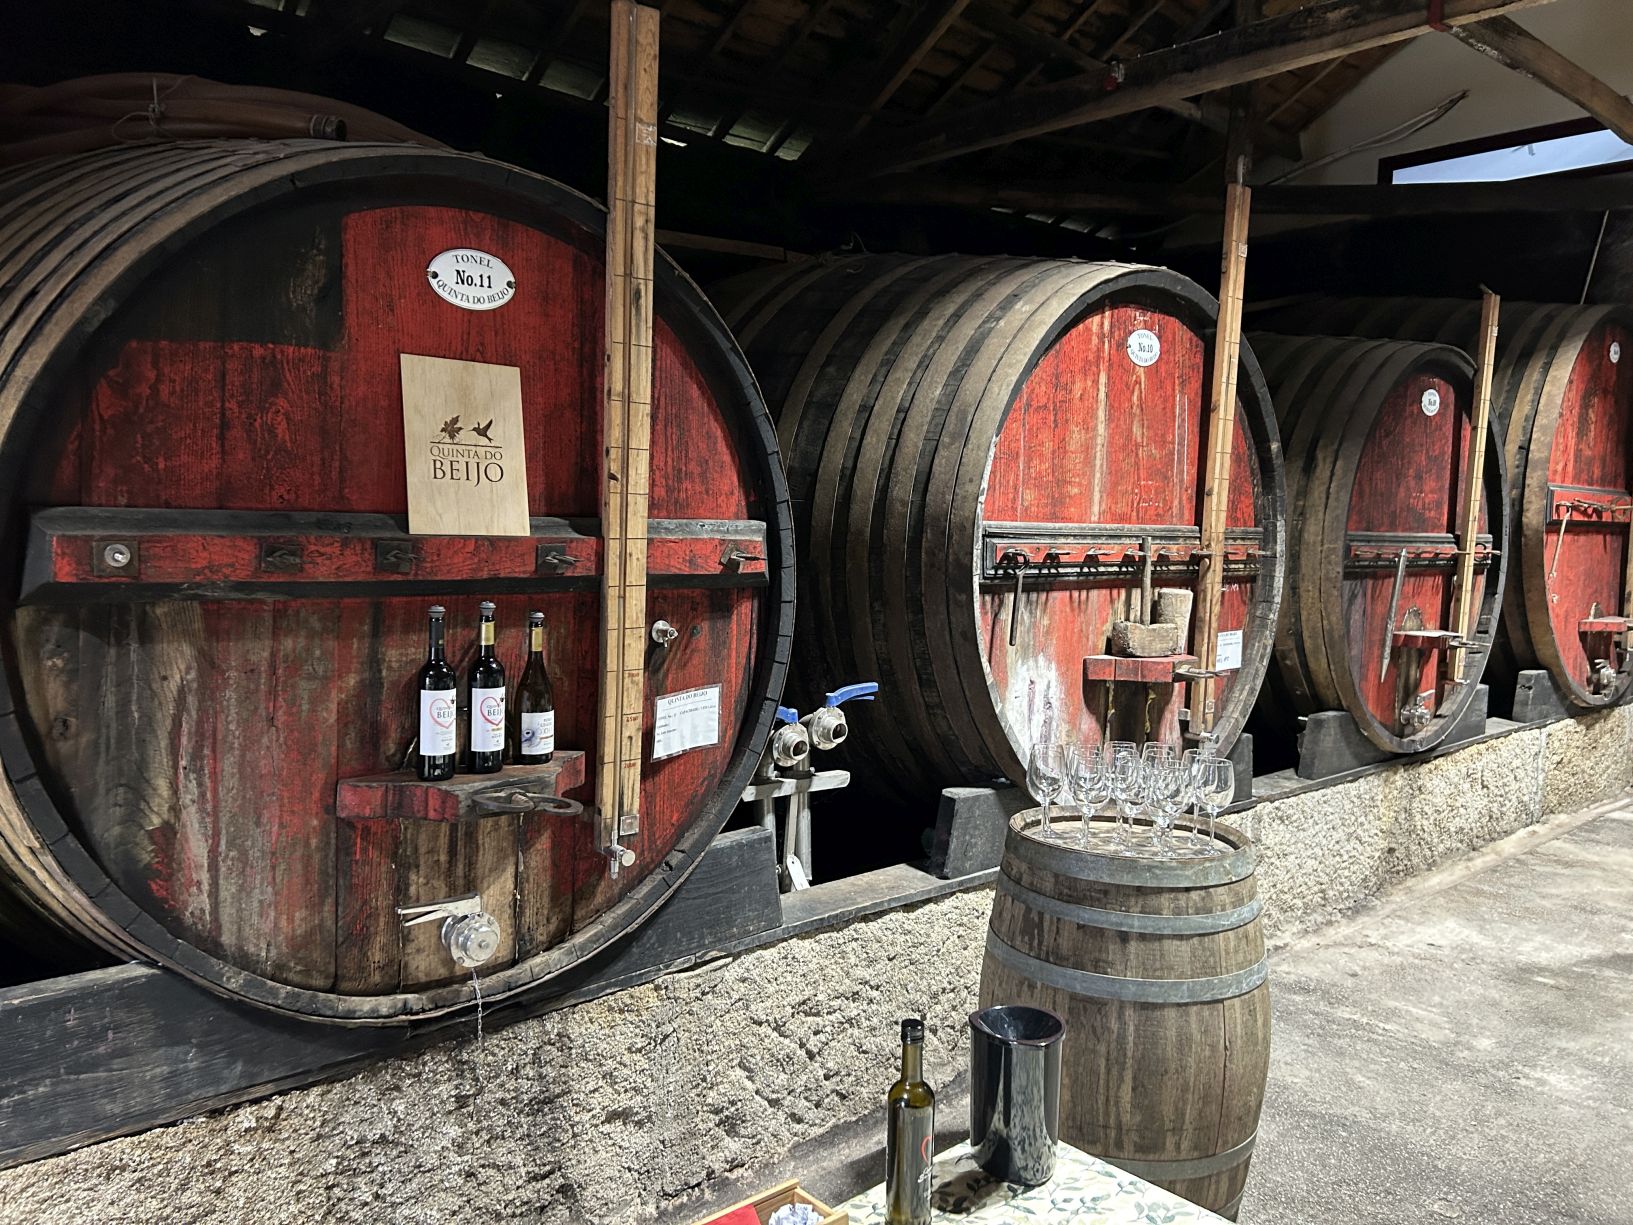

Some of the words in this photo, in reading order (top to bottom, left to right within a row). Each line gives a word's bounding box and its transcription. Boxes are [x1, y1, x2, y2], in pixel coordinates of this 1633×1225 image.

[452, 254, 493, 269] TONEL
[455, 269, 492, 289] No.11
[436, 279, 470, 304] QUINTA
[472, 295, 486, 305] DO
[486, 287, 510, 304] BEIJO
[430, 445, 480, 460] QUINTA
[484, 450, 503, 461] DO
[431, 458, 504, 487] BEIJO
